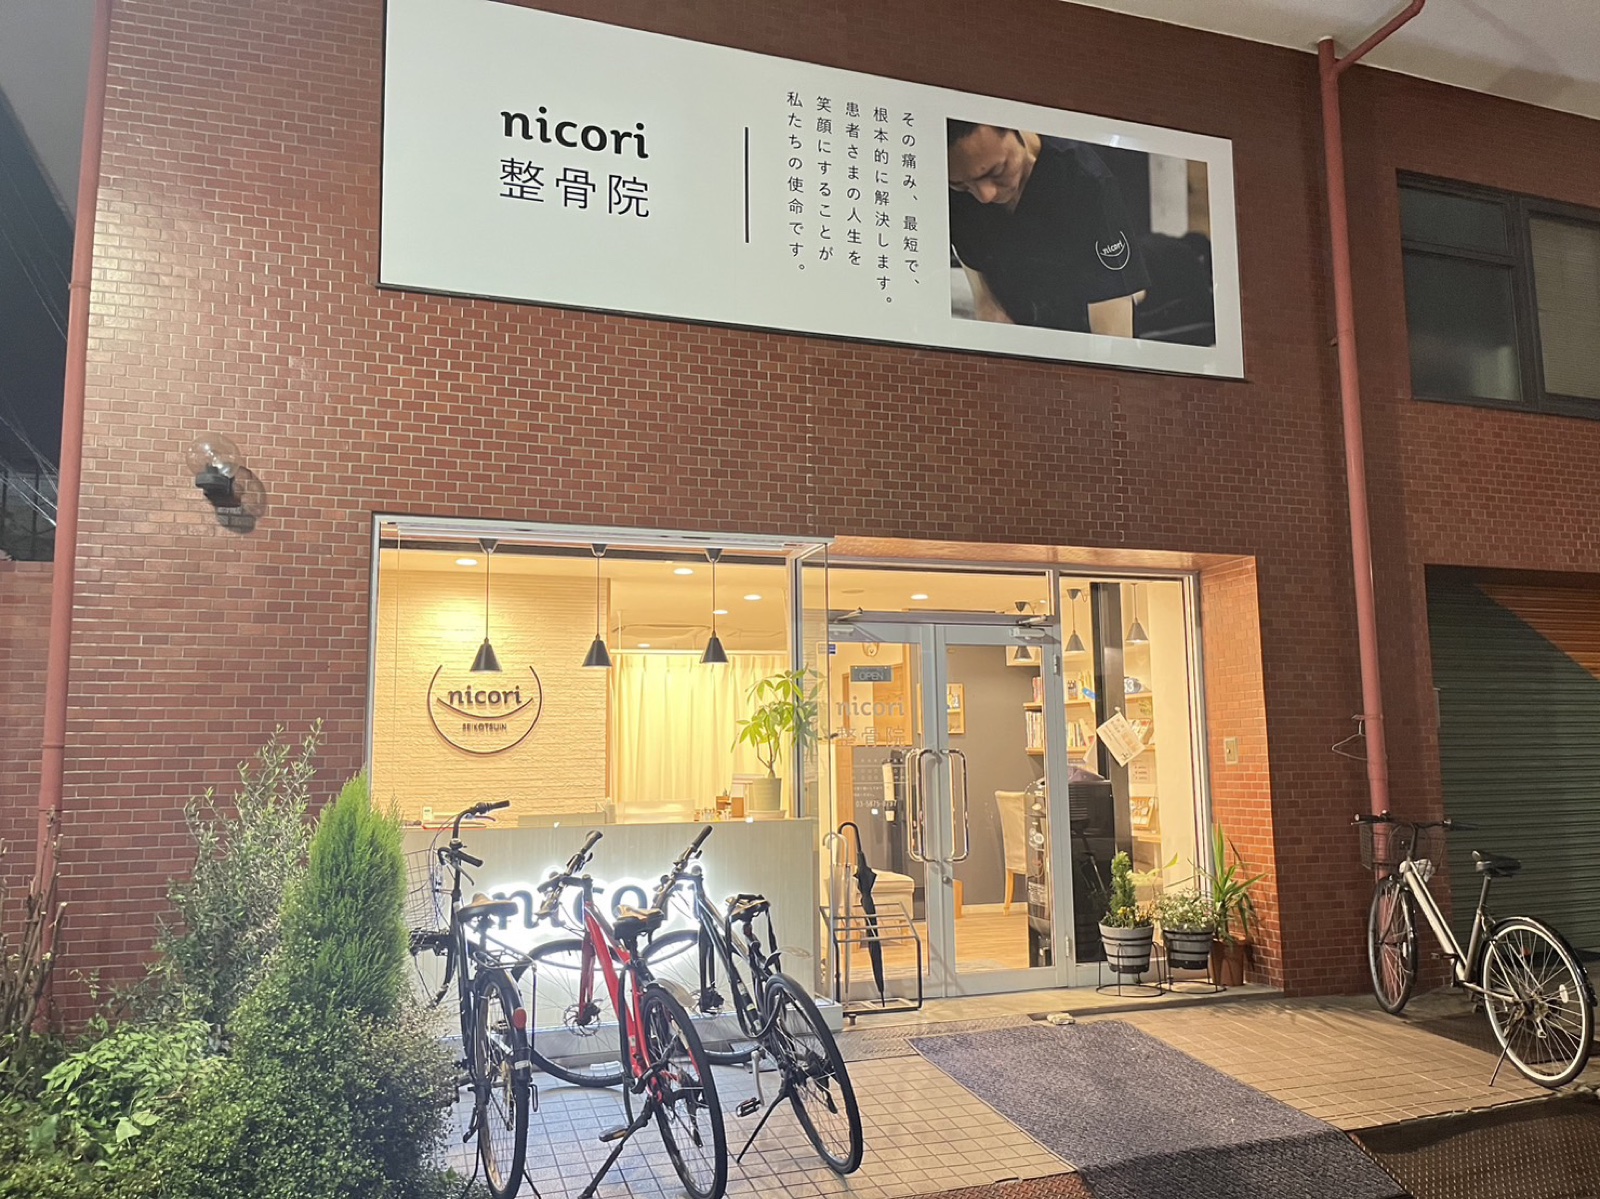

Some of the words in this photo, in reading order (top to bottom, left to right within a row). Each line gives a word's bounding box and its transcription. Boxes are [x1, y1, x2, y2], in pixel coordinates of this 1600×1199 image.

[500, 106, 649, 159] nicori
[500, 157, 650, 218] 整骨院
[786, 91, 806, 271] 私たちの使命です。
[816, 96, 834, 261] 笑顔にすることが
[845, 102, 862, 266] 患者さまの人生を
[873, 106, 893, 304] 根本的に解決します。
[901, 112, 920, 284] その痛み、最短で、
[448, 685, 522, 705] nicori
[859, 671, 884, 680] OPEN
[462, 723, 508, 732] SEIKOTSUIN
[836, 696, 905, 717] nicori
[836, 725, 906, 747] 整骨院
